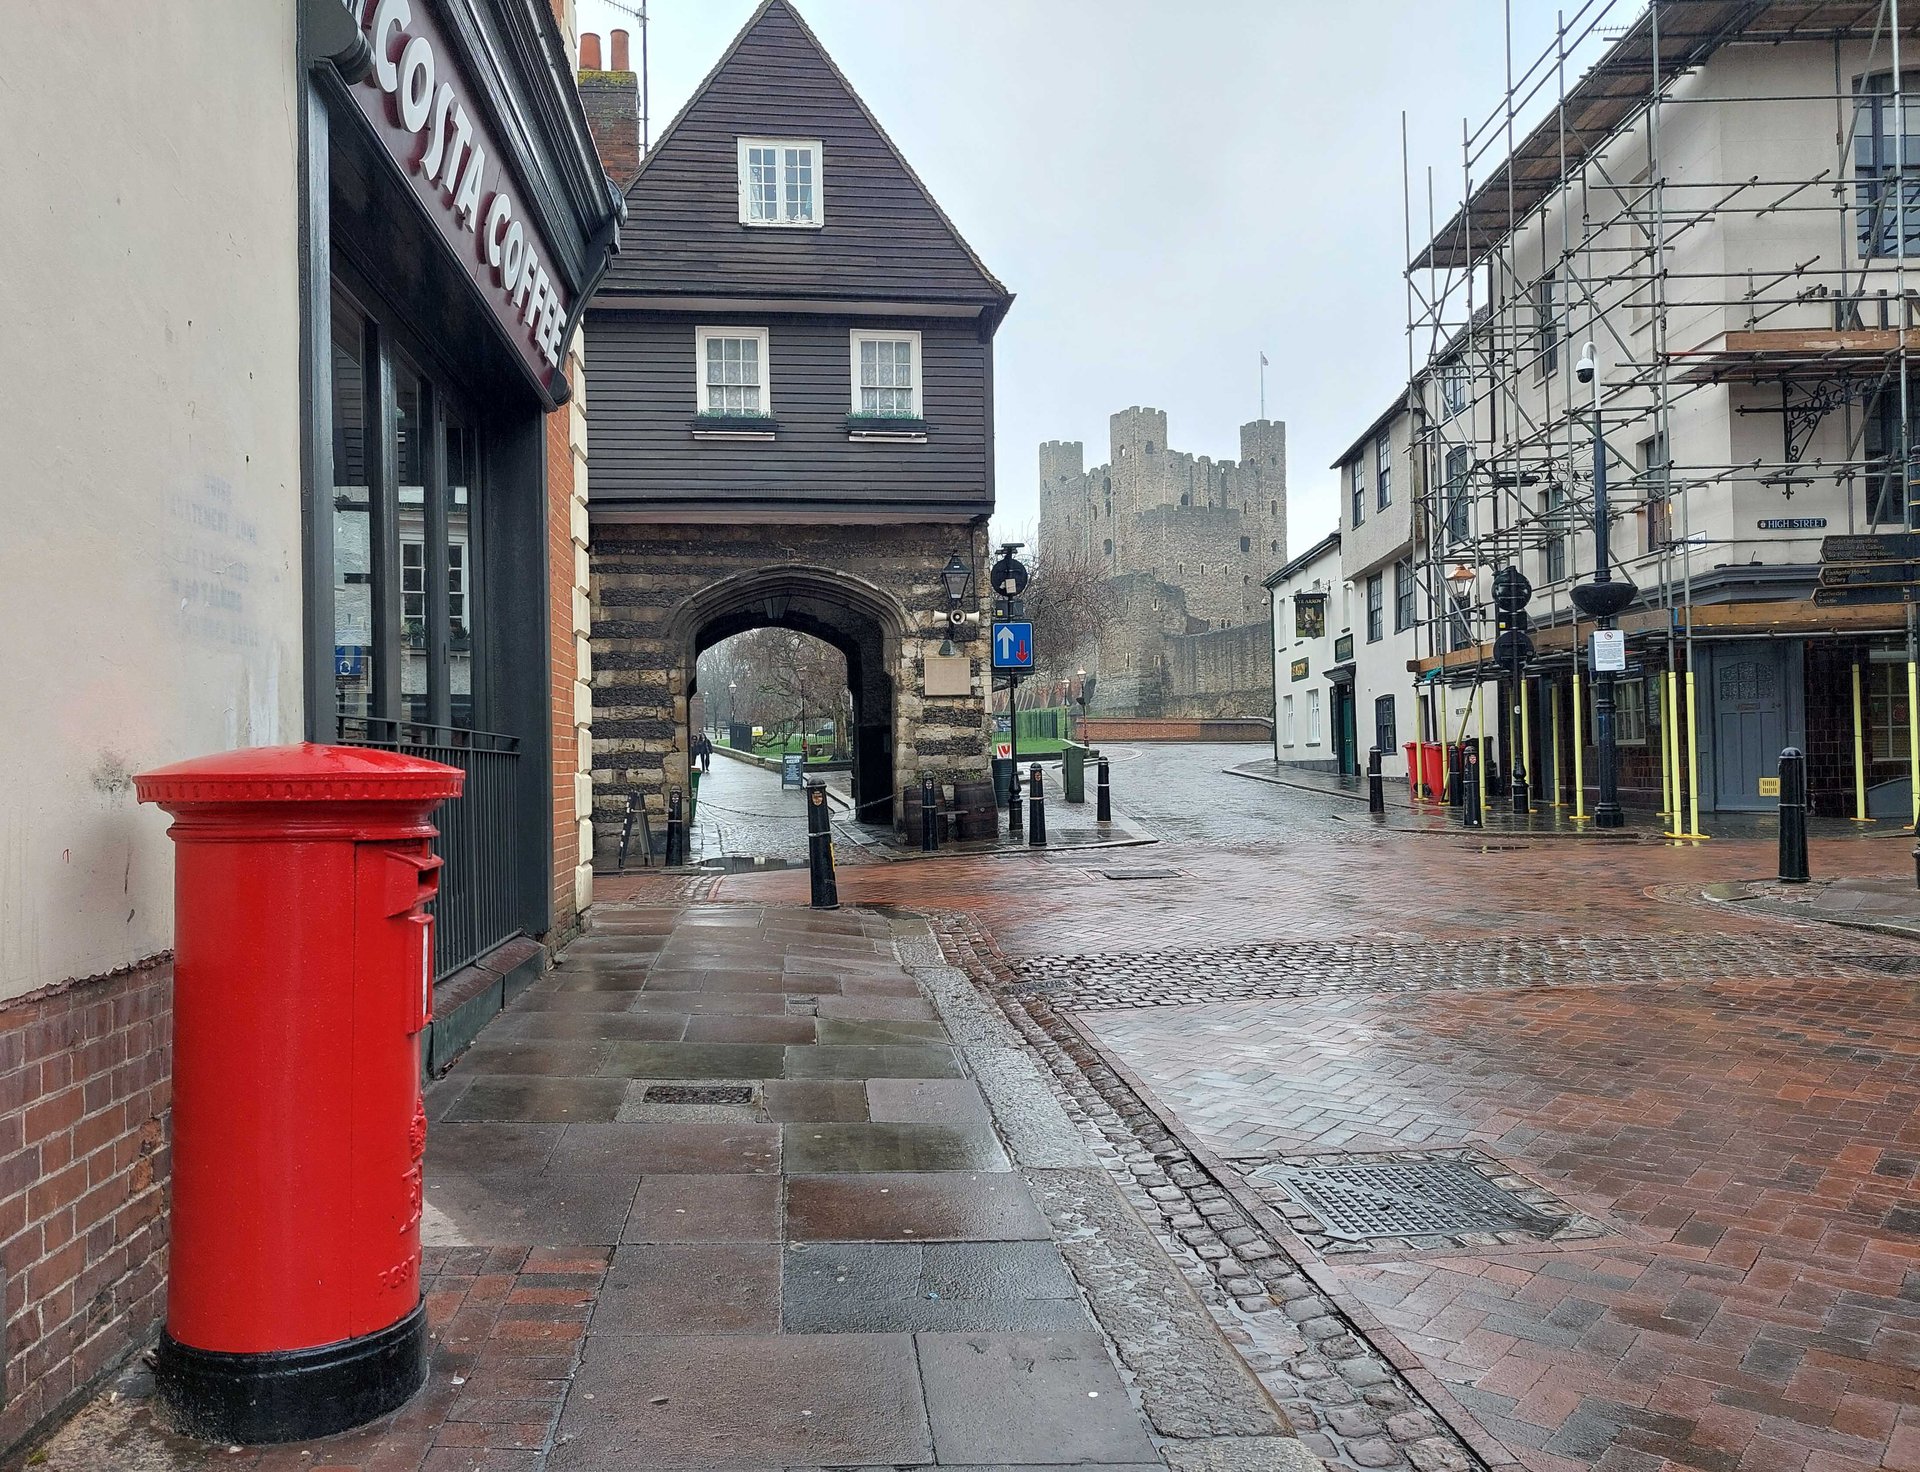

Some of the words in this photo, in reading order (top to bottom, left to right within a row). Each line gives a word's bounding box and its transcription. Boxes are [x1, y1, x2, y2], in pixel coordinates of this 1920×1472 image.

[372, 0, 485, 233] COSTA
[484, 193, 566, 368] COFFEE
[1768, 519, 1790, 529] HIGH
[1793, 518, 1825, 528] STREET
[1825, 569, 1850, 577] Eastgate
